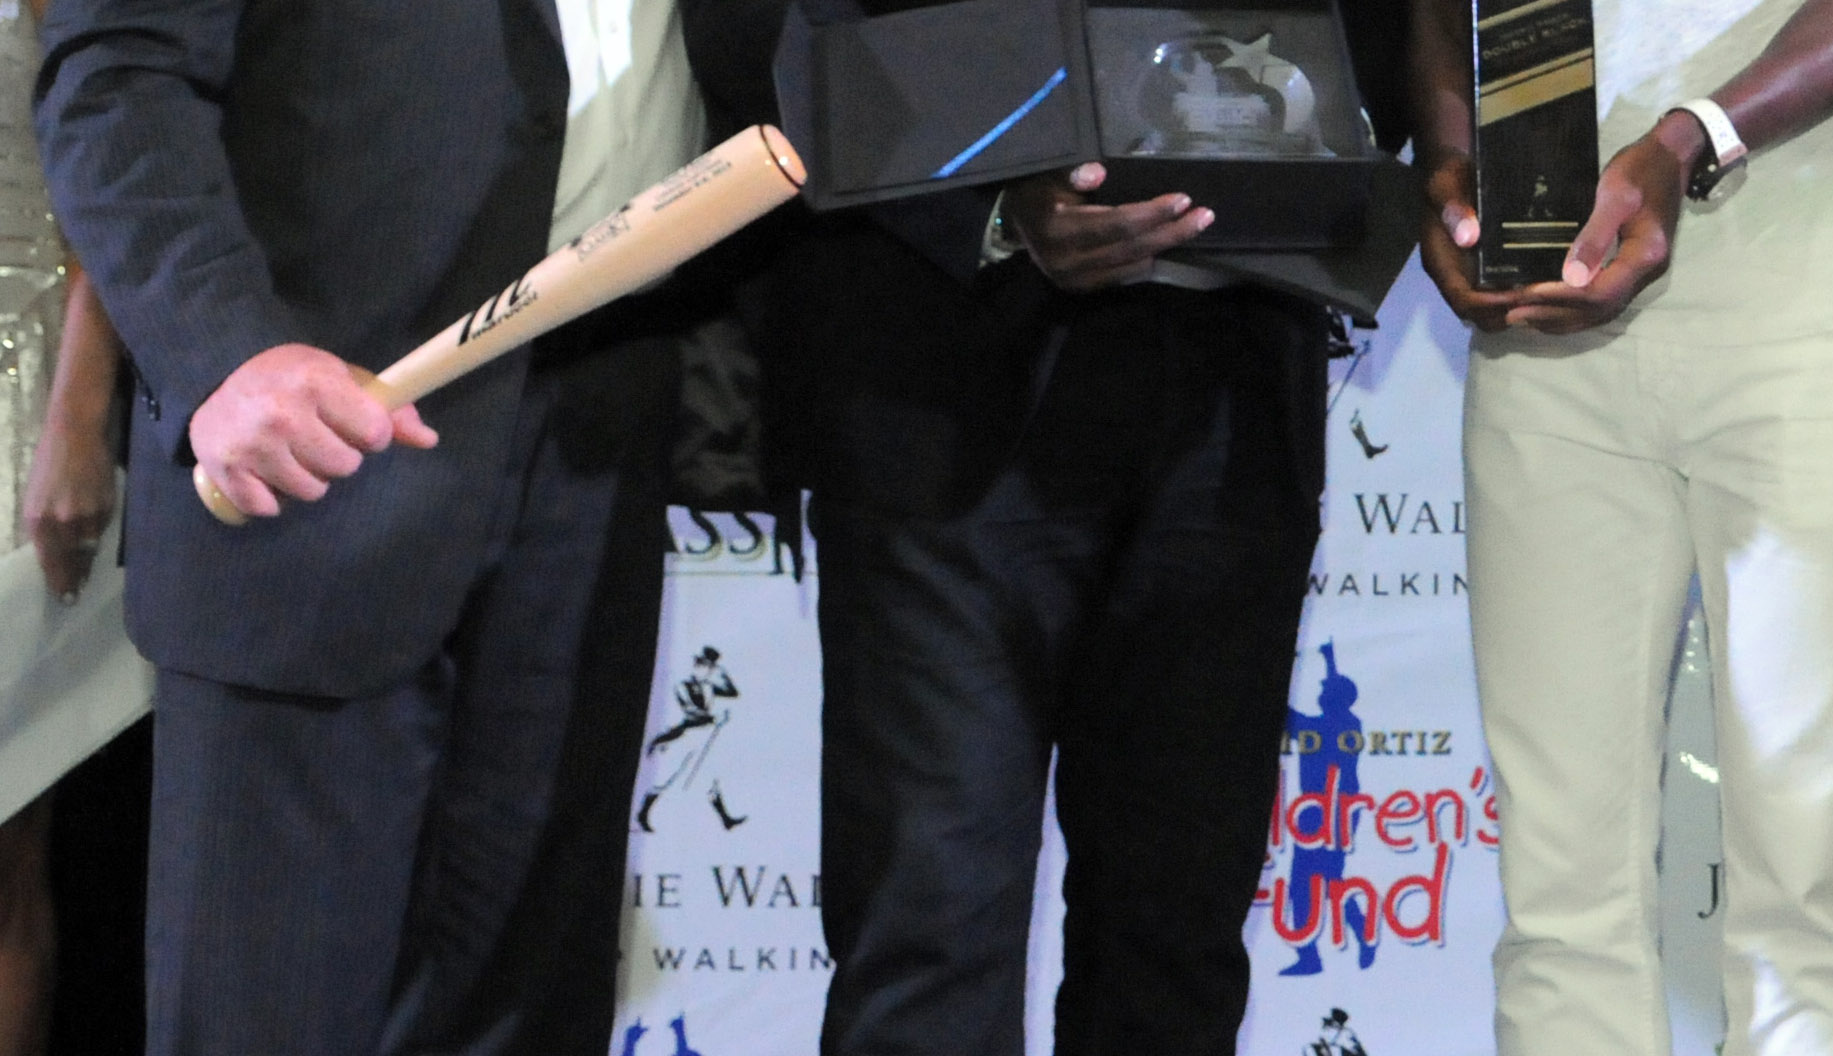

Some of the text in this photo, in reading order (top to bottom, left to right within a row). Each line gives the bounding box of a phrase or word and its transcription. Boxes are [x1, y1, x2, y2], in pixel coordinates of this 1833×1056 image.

[1307, 572, 1469, 596] WALKIN
[1336, 730, 1453, 756] ORTIZ
[1264, 841, 1449, 947] und
[652, 947, 832, 971] WALKIN
